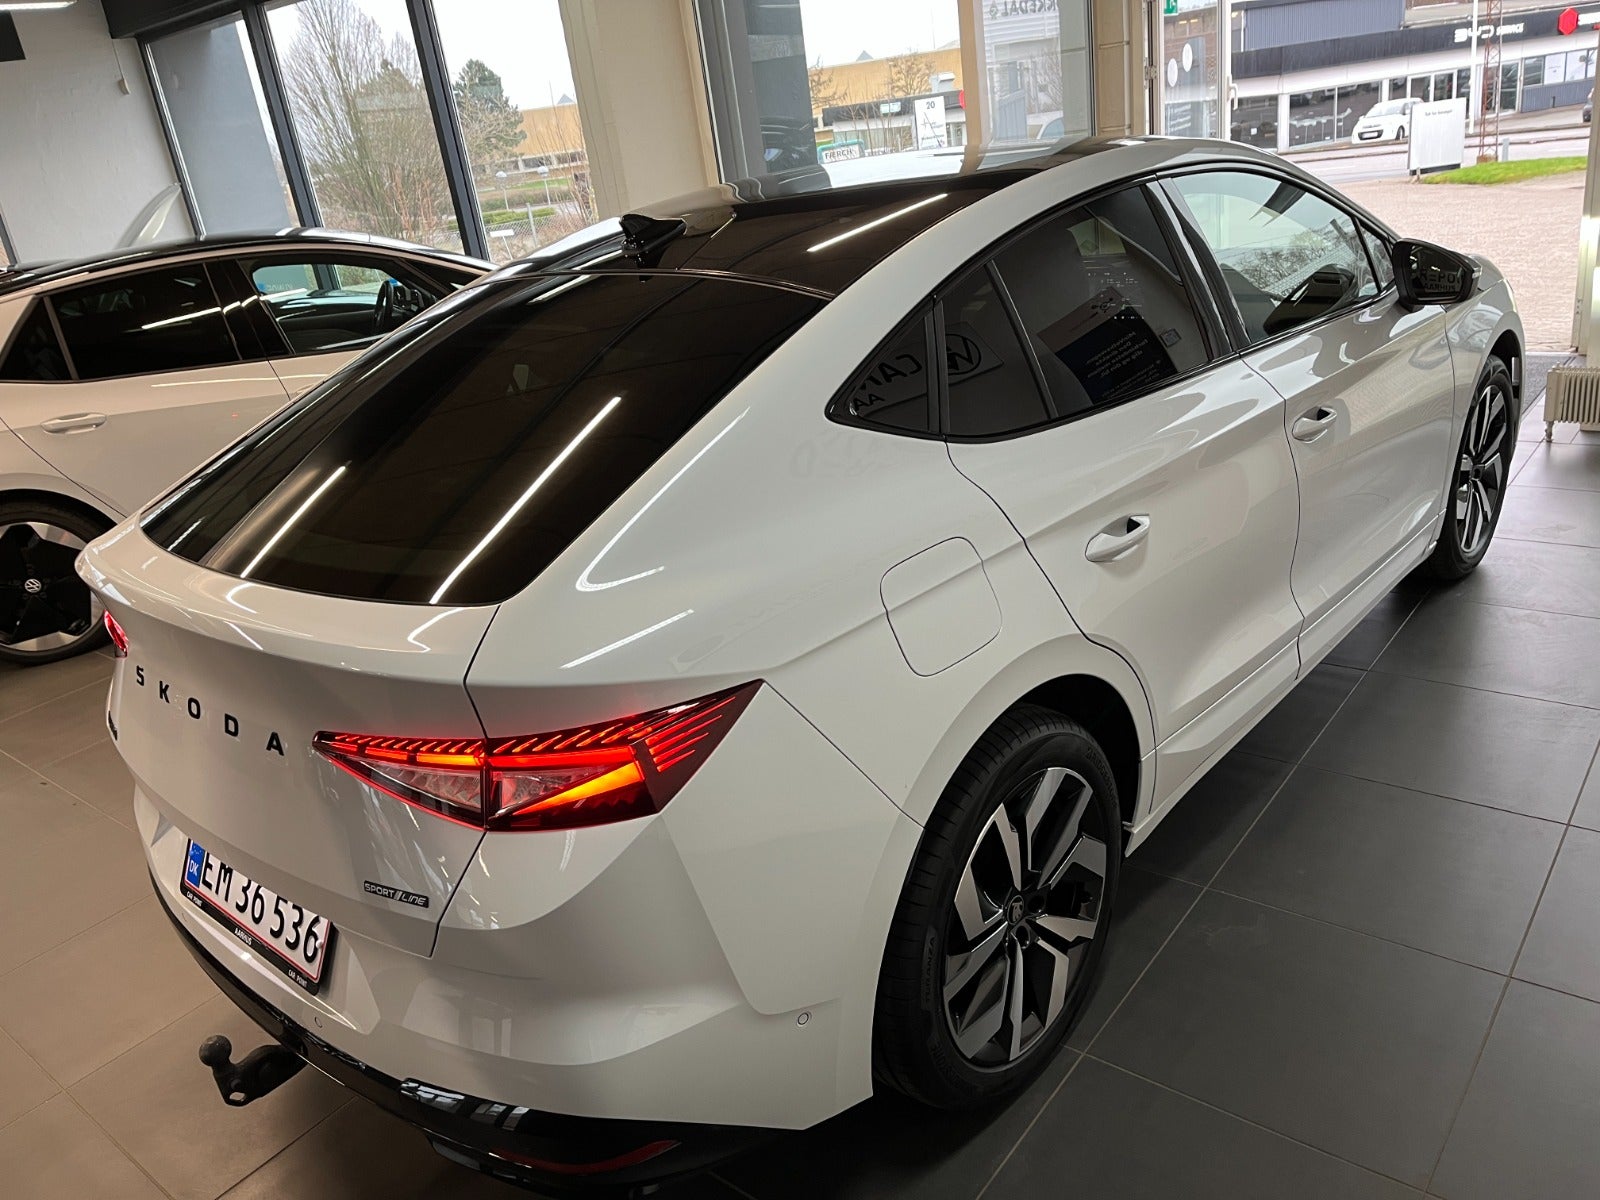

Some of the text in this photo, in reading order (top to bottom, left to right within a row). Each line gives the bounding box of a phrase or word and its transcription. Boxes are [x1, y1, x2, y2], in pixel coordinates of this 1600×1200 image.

[926, 101, 935, 110] 20
[189, 859, 199, 877] DK
[364, 883, 395, 898] SPORT
[202, 851, 321, 964] EM 36 536
